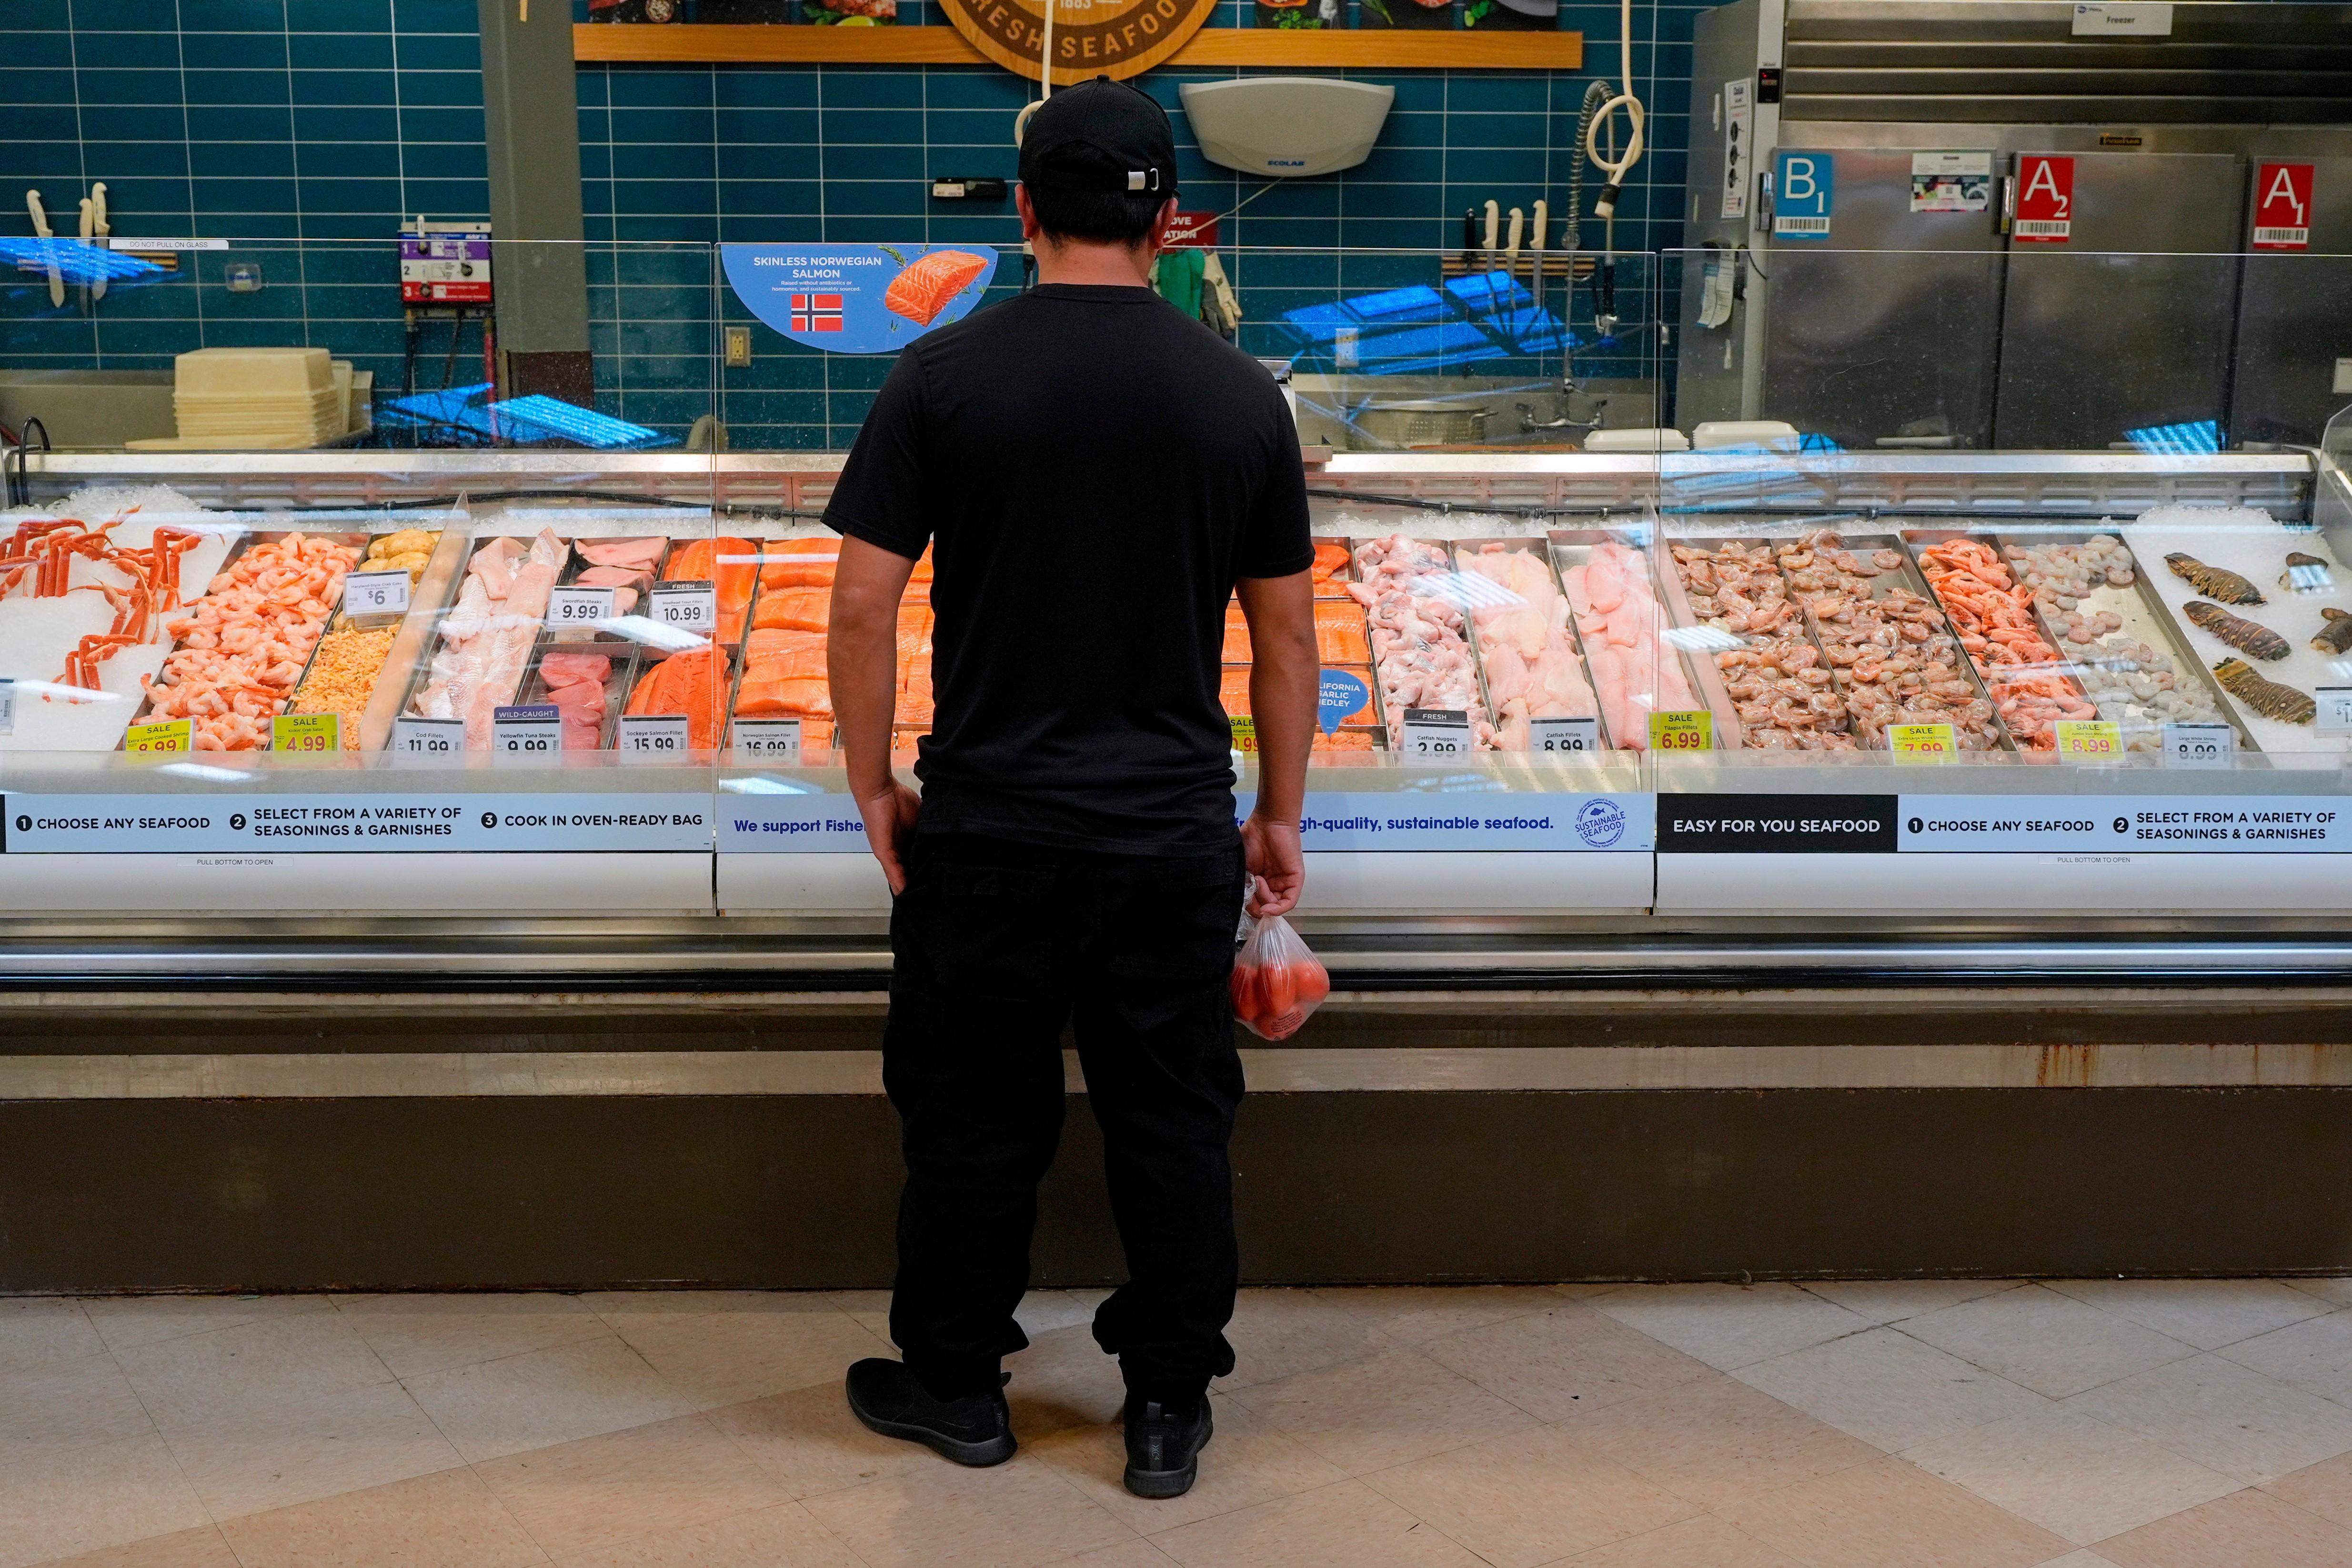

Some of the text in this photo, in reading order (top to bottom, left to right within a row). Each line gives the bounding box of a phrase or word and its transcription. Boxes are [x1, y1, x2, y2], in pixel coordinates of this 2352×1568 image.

[971, 0, 1177, 58] ESH SEAFOO
[1172, 217, 1192, 225] OVE
[1164, 230, 1197, 239] ATION
[754, 257, 881, 266] SKINLESS NORWEGIAN
[404, 266, 410, 275] 2
[793, 269, 840, 278] SALMON
[404, 287, 412, 297] 3
[368, 590, 385, 605] $6
[563, 605, 598, 619] 9.99
[664, 607, 700, 621] 10.99
[1319, 682, 1360, 692] LIFORNIA
[1319, 699, 1349, 707] EDLEY
[293, 718, 318, 726] SALE
[1669, 714, 1692, 722] SALE
[147, 724, 171, 734] SALE
[139, 739, 176, 751] 899
[286, 735, 325, 751] 4.99
[409, 739, 449, 751] 1199
[634, 738, 674, 750] 1599
[1662, 732, 1700, 749] 6.99
[2072, 739, 2110, 752] 8.99
[746, 741, 786, 756] 16.99
[2179, 744, 2217, 760] 8.99
[254, 807, 462, 820] SELECT FROM A VARIETY OF
[2137, 812, 2336, 823] SELECT FROM A VARIETY OF
[37, 817, 210, 829] CHOOSE ANY SEAFOOD
[505, 814, 702, 826] COOK IN OVEN-READY BAG
[1300, 816, 1554, 833] gh-quality, sustainable seafood.
[1575, 811, 1626, 832] SUSTAINABLE
[1674, 820, 1880, 832] EASY FOR YOU SEAFOOD
[254, 824, 452, 836] SEASONINGS & GARNISHES
[734, 820, 866, 834] We support Fishe
[1583, 821, 1621, 838] SEAFOOD
[1928, 821, 2094, 832] CHOOSE ANY SEAFOOD
[2136, 829, 2325, 839] SEASONINGS & GARNISHES
